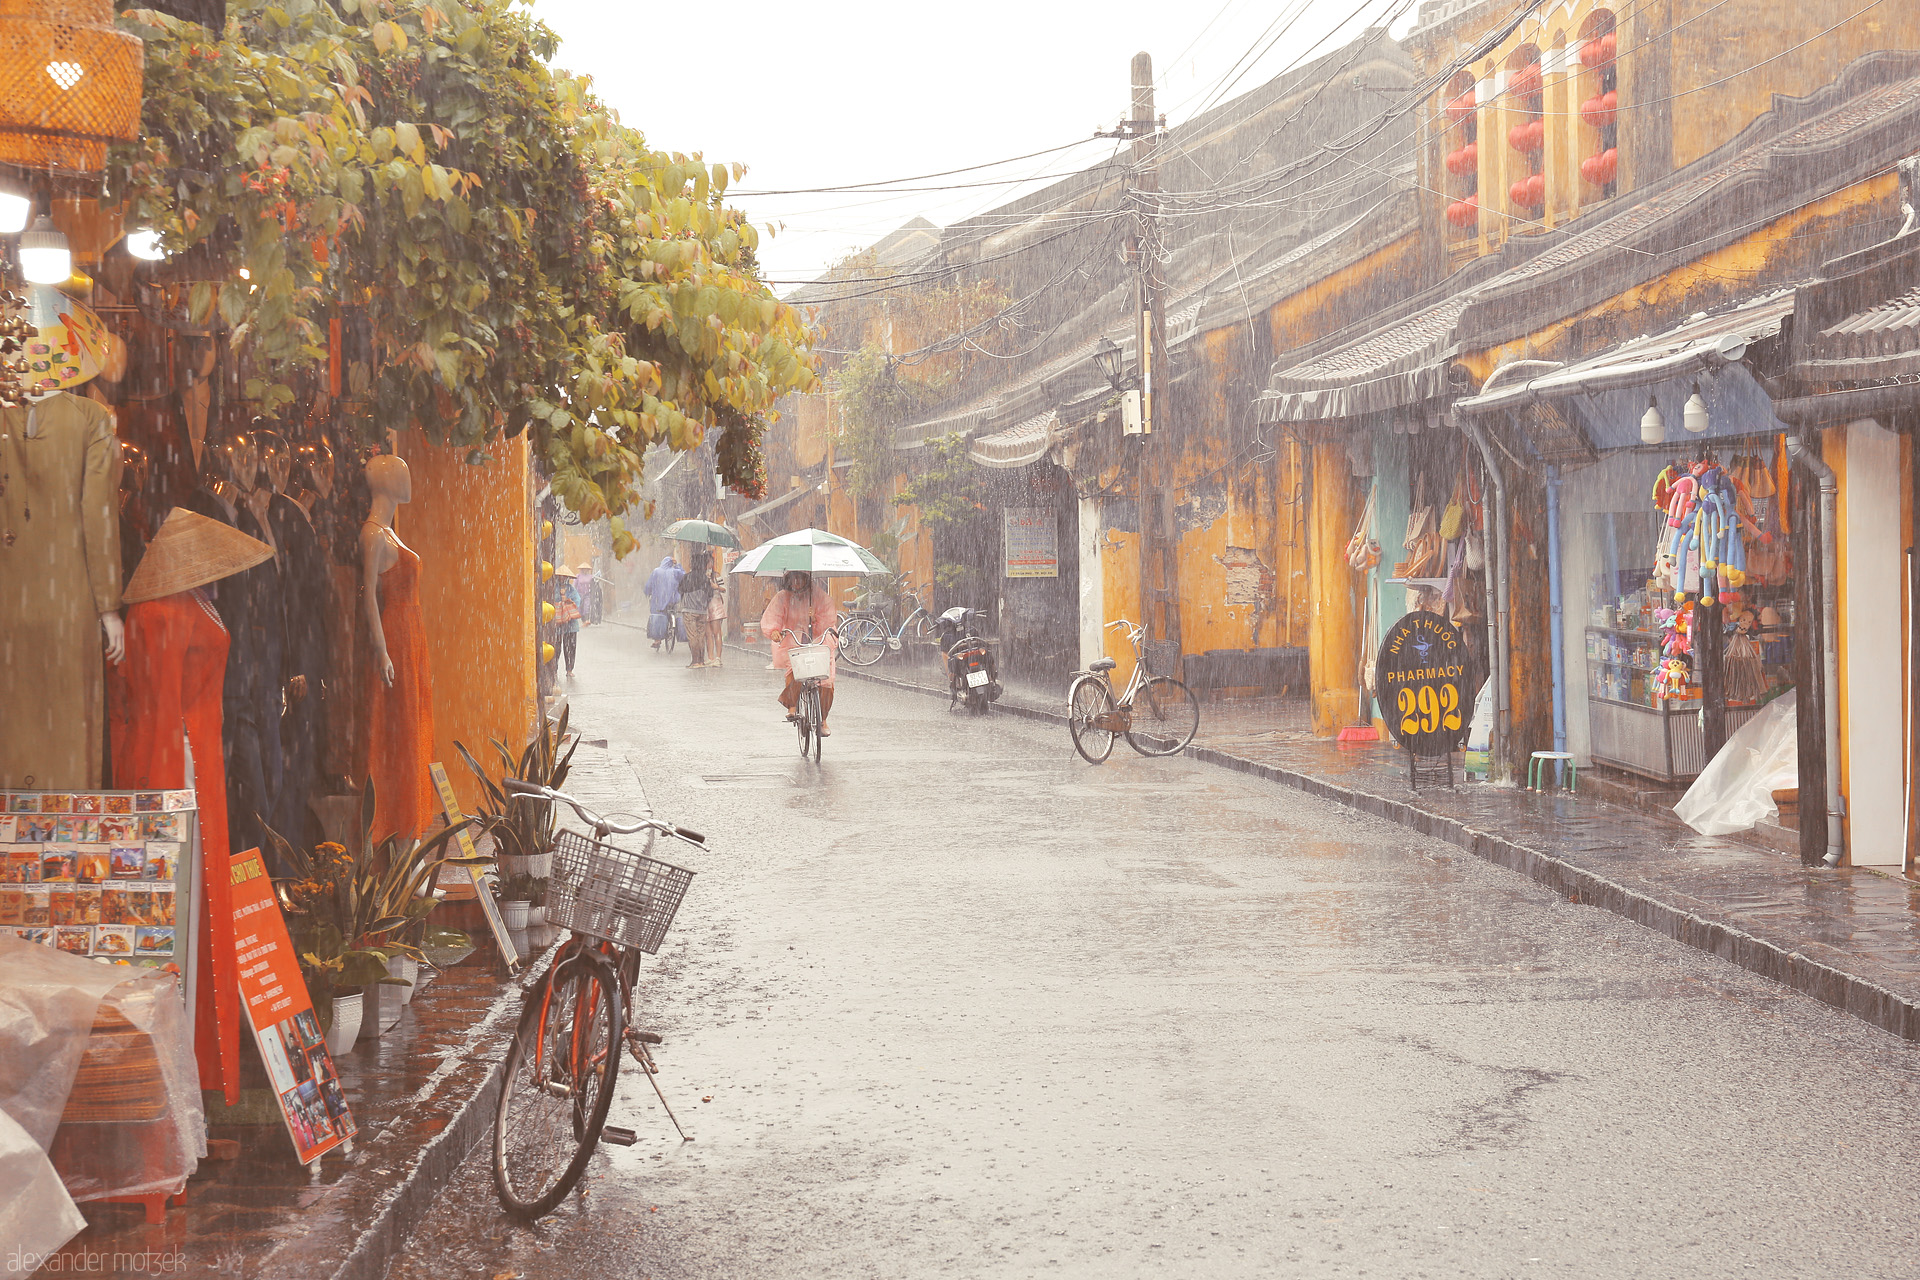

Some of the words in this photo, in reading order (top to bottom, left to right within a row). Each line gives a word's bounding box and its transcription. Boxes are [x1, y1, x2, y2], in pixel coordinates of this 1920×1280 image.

[1389, 627, 1411, 654] NHÀ
[1412, 619, 1457, 650] THUỐC
[1387, 665, 1464, 683] PHARMACY
[1397, 683, 1462, 736] 292
